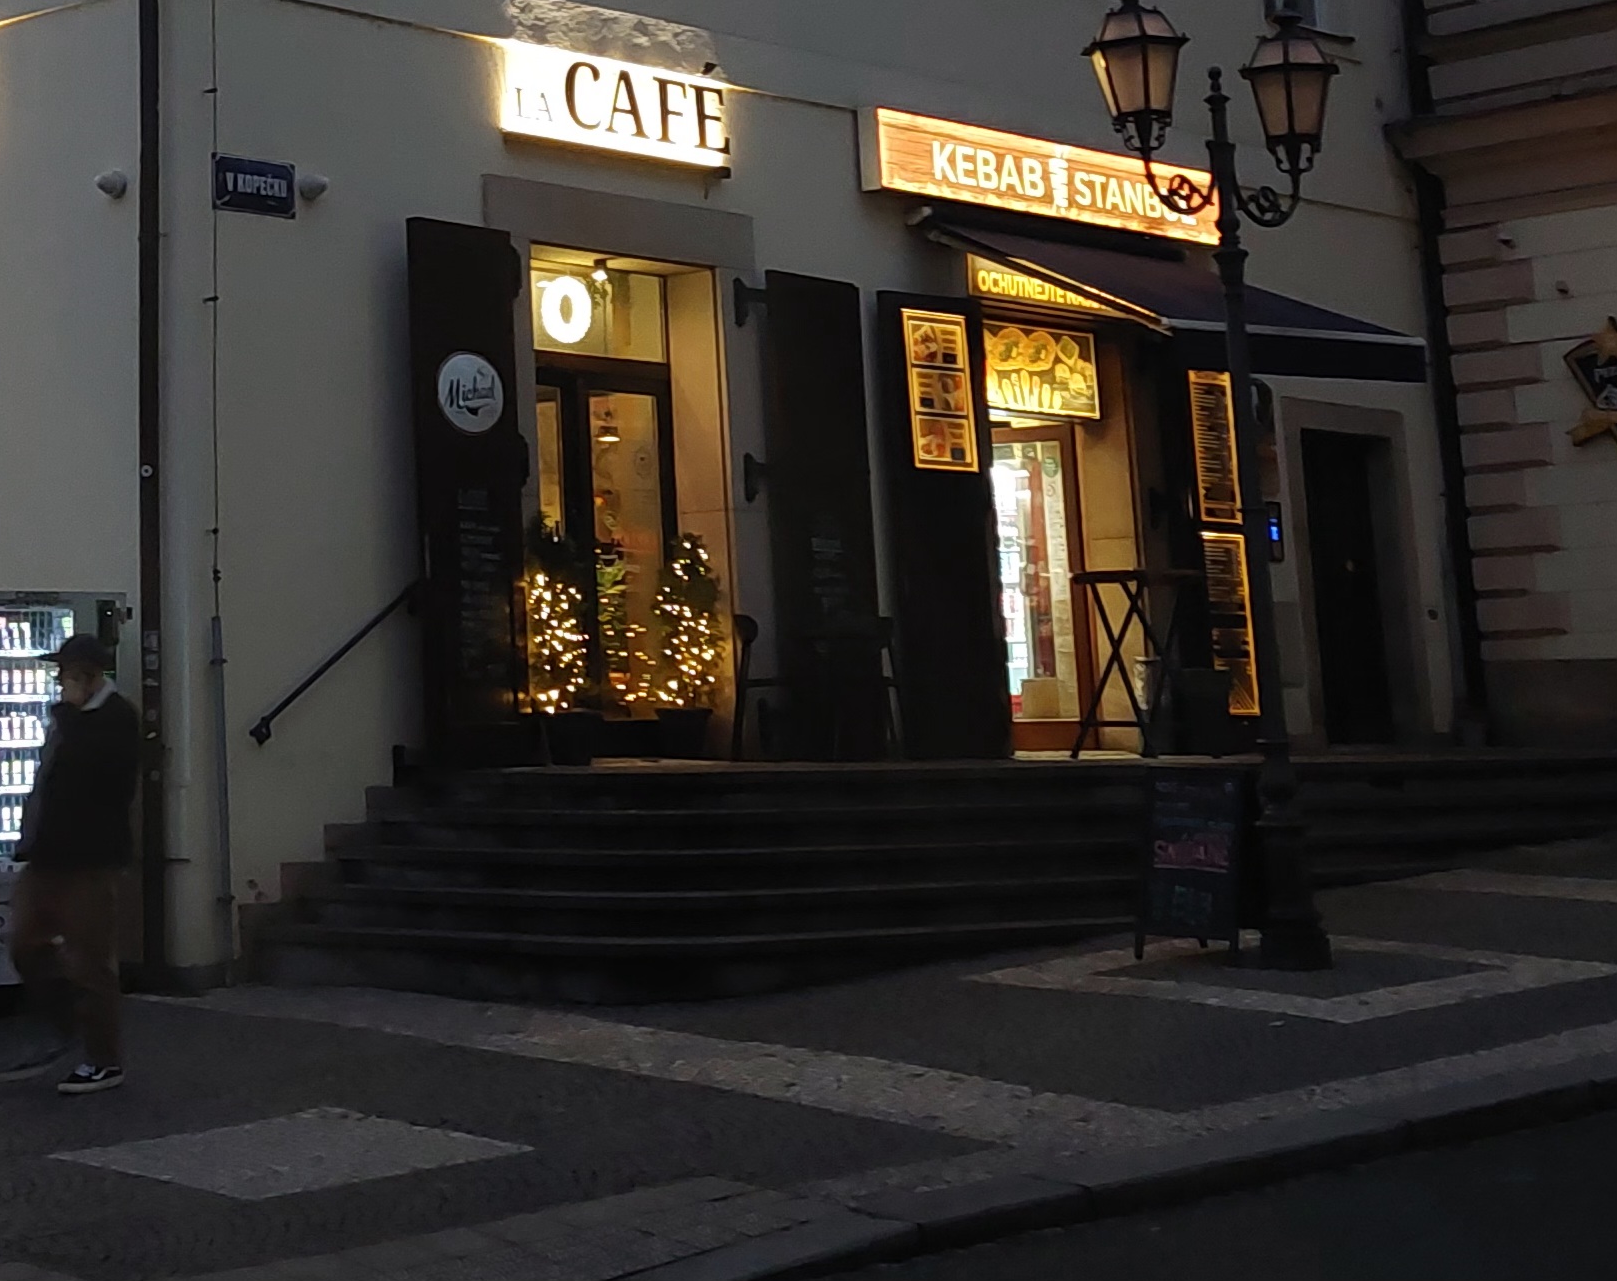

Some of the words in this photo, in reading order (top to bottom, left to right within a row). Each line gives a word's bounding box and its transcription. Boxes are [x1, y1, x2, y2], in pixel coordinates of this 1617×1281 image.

[514, 86, 555, 123] LA
[224, 171, 236, 193] V
[236, 172, 288, 199] KOPEČKU
[931, 140, 1045, 200] KEBAB
[977, 269, 1065, 304] OCHUTNEJTE
